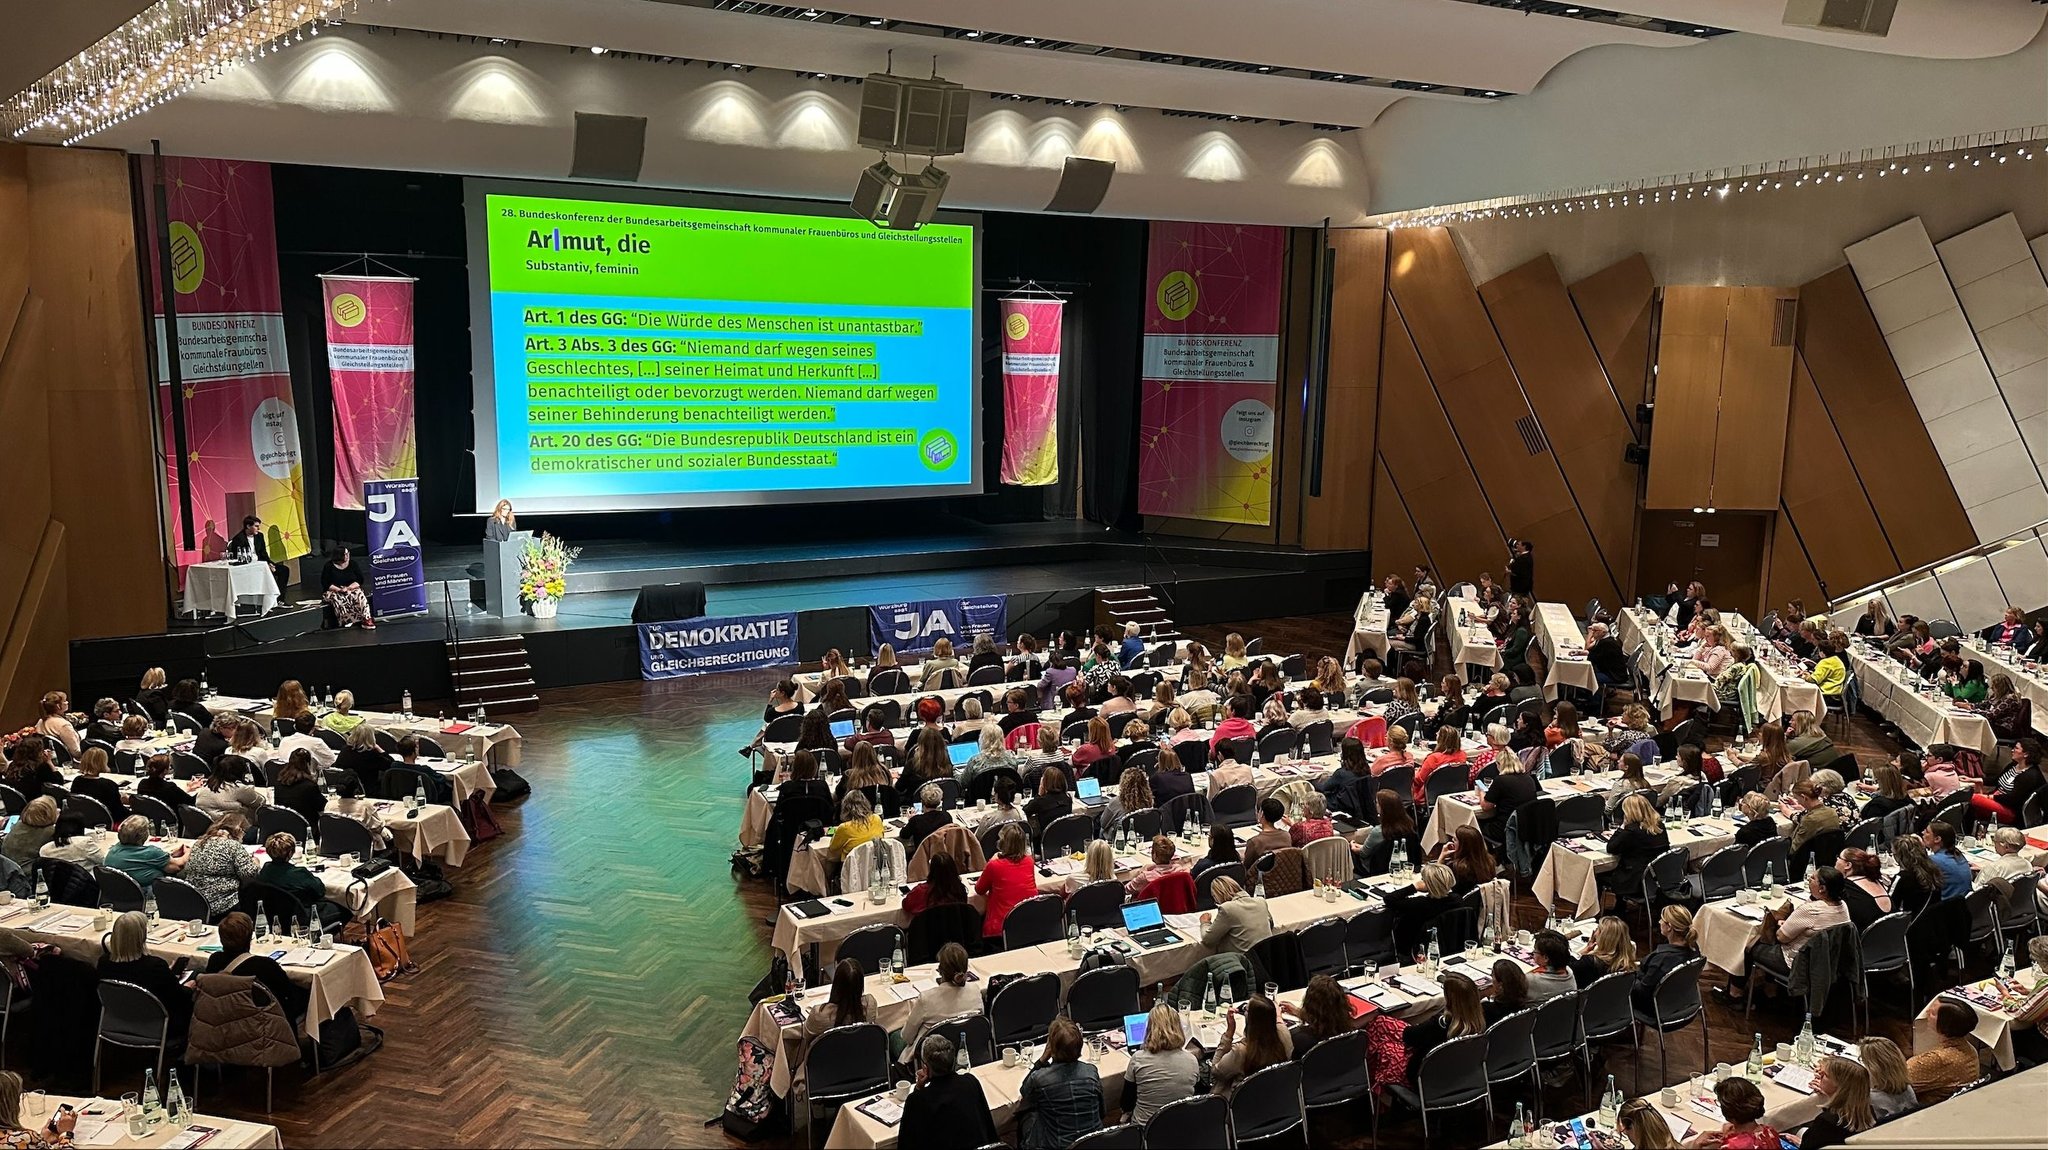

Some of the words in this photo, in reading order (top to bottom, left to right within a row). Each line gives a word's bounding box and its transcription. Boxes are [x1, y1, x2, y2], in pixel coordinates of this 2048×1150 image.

[501, 208, 516, 218] 28.
[519, 209, 605, 223] Bundeskonferenz
[607, 215, 623, 224] der
[625, 216, 751, 232] Bundesarbeitsgemeinschaft
[754, 224, 806, 236] kommunaler
[808, 228, 860, 239] Frauenbüros
[861, 231, 876, 240] und
[878, 232, 963, 244] Gleichstellungsstellen
[618, 233, 651, 254] die
[526, 260, 592, 274] Substantiv,
[595, 262, 639, 275] feminin
[524, 310, 552, 324] Art.
[557, 310, 565, 323] 1
[570, 311, 597, 324] des
[602, 313, 628, 326] GG:
[666, 314, 713, 328] Würde
[717, 316, 742, 328] des
[746, 318, 814, 332] Menschen
[818, 318, 834, 332] ist
[525, 338, 554, 351] Art.
[558, 338, 567, 351] 3
[571, 338, 604, 352] Abs.
[608, 339, 616, 352] 3
[621, 339, 648, 352] des
[652, 340, 677, 353] GG:
[754, 342, 782, 356] darf
[786, 346, 828, 359] wegen
[832, 344, 873, 356] seines
[1178, 339, 1242, 347] BUNDESKONFERENZ
[1164, 348, 1255, 358] Bundesarbeitsgemeinschaft
[526, 361, 634, 378] Geschlechtes,
[665, 362, 710, 376] seiner
[714, 364, 764, 376] Heimat
[768, 364, 793, 377] und
[798, 364, 854, 378] Herkunft
[1164, 358, 1204, 367] kommunaler
[1172, 368, 1245, 378] Gleichstellungsstellen
[528, 384, 630, 402] benachteiligt
[635, 386, 669, 398] oder
[674, 386, 744, 402] bevorzugt
[748, 387, 801, 400] werden.
[805, 387, 863, 399] Niemand
[866, 386, 892, 399] darf
[895, 389, 934, 402] wegen
[528, 407, 578, 421] seiner
[583, 407, 679, 424] Behinderung
[683, 406, 774, 422] benachteiligt
[530, 434, 558, 448] Art.
[562, 434, 581, 448] 20
[586, 434, 613, 447] des
[616, 434, 643, 447] GG:
[681, 432, 790, 448] Bundesrepublik
[793, 430, 872, 444] Deutschland
[876, 430, 892, 444] ist
[895, 430, 914, 444] ein
[532, 456, 652, 471] demokratischer
[656, 455, 684, 468] und
[688, 454, 742, 468] sozialer
[373, 556, 415, 564] Gleichstellung
[894, 609, 955, 640] JA
[650, 619, 789, 650] DEMOKRATIE
[651, 646, 790, 672] GLEICHBERECHTIGUNG
